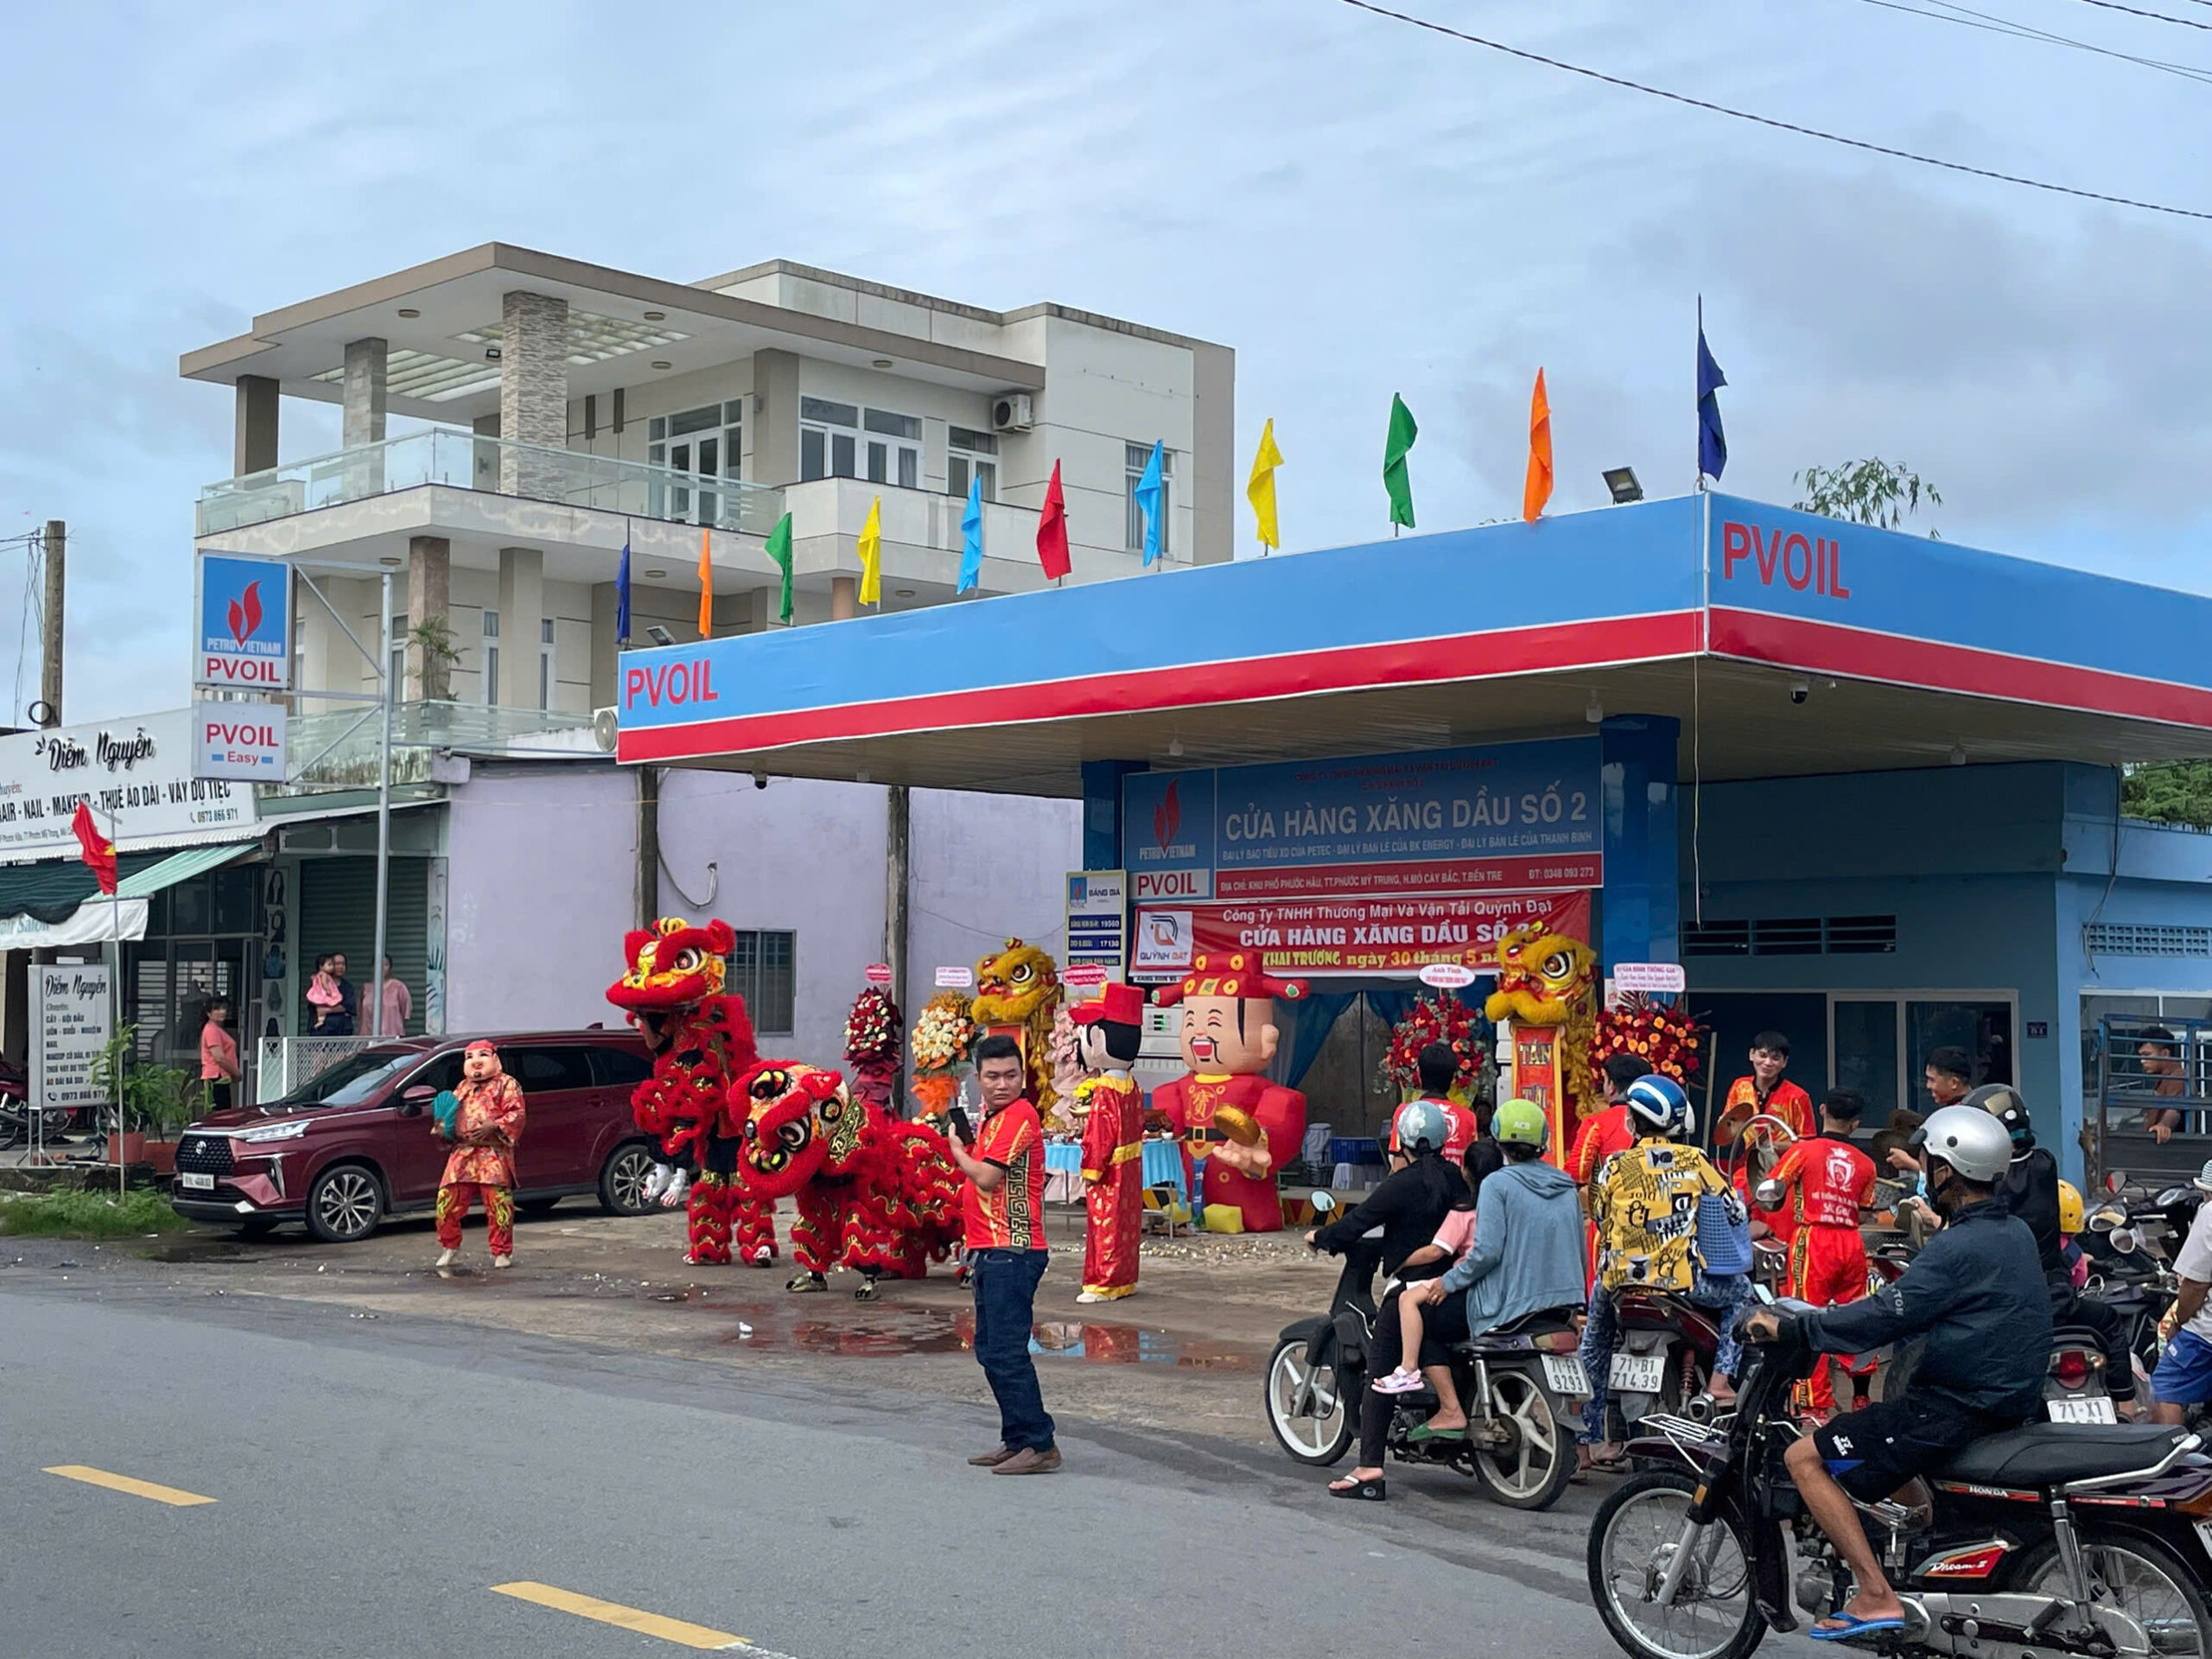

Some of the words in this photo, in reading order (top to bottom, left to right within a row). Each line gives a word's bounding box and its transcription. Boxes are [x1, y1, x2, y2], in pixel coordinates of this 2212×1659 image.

[1724, 521, 1850, 600] PVOIL
[207, 637, 281, 656] PETROVIETNAM
[207, 658, 281, 683] PVOIL
[627, 658, 718, 710] PVOIL
[207, 723, 279, 747] PVOIL
[49, 737, 88, 771] Diễm
[96, 727, 156, 771] Nguyễn
[227, 751, 258, 766] Easy
[23, 798, 45, 819] NAIL
[99, 784, 124, 810] THUÊ
[127, 783, 140, 808] ÁO
[142, 780, 160, 806] DÀI
[168, 777, 188, 804] VÁY
[1225, 802, 1276, 842] CỬA
[1284, 801, 1357, 837] HÀNG
[1366, 795, 1442, 832] XĂNG
[1452, 785, 1511, 829] DẦU
[1521, 779, 1562, 824] SỐ
[1571, 791, 1586, 821] 2
[1139, 843, 1196, 861] PETROVIETNAM
[1307, 844, 1331, 856] PETEC
[1409, 840, 1421, 851] BK
[1422, 838, 1454, 852] ENERGY
[1540, 831, 1569, 844] THANH
[1137, 872, 1198, 896] PVOIL
[1485, 870, 1503, 881] TRE
[1580, 866, 1595, 877] 273
[1223, 909, 1255, 923] Công
[1259, 908, 1273, 923] Ty
[1277, 907, 1313, 920] TNHH
[1317, 906, 1366, 921] Thương
[1370, 905, 1393, 920] Mại
[1397, 904, 1414, 917] Và
[1419, 903, 1445, 919] Vận
[1449, 900, 1470, 916] Tải
[1474, 900, 1522, 918] Quỳnh
[1527, 899, 1552, 915] Đạt
[1240, 925, 1281, 946] CỬA
[1287, 925, 1345, 945] HÀNG
[1353, 923, 1414, 945] XĂNG
[1421, 918, 1469, 944] DẦU
[1476, 917, 1509, 942] SỐ
[1140, 949, 1170, 960] QUỲNH
[1262, 951, 1291, 967] KHAI
[1346, 952, 1386, 969] ngày
[1390, 951, 1410, 965] 30
[1414, 950, 1462, 966] tháng
[1466, 950, 1476, 964] 5
[46, 975, 69, 997] Diễm
[73, 974, 107, 1001] Nguyễn
[1554, 1375, 1583, 1391] 9293
[1612, 1373, 1657, 1389] 714.39
[1969, 1485, 2009, 1497] HONDA
